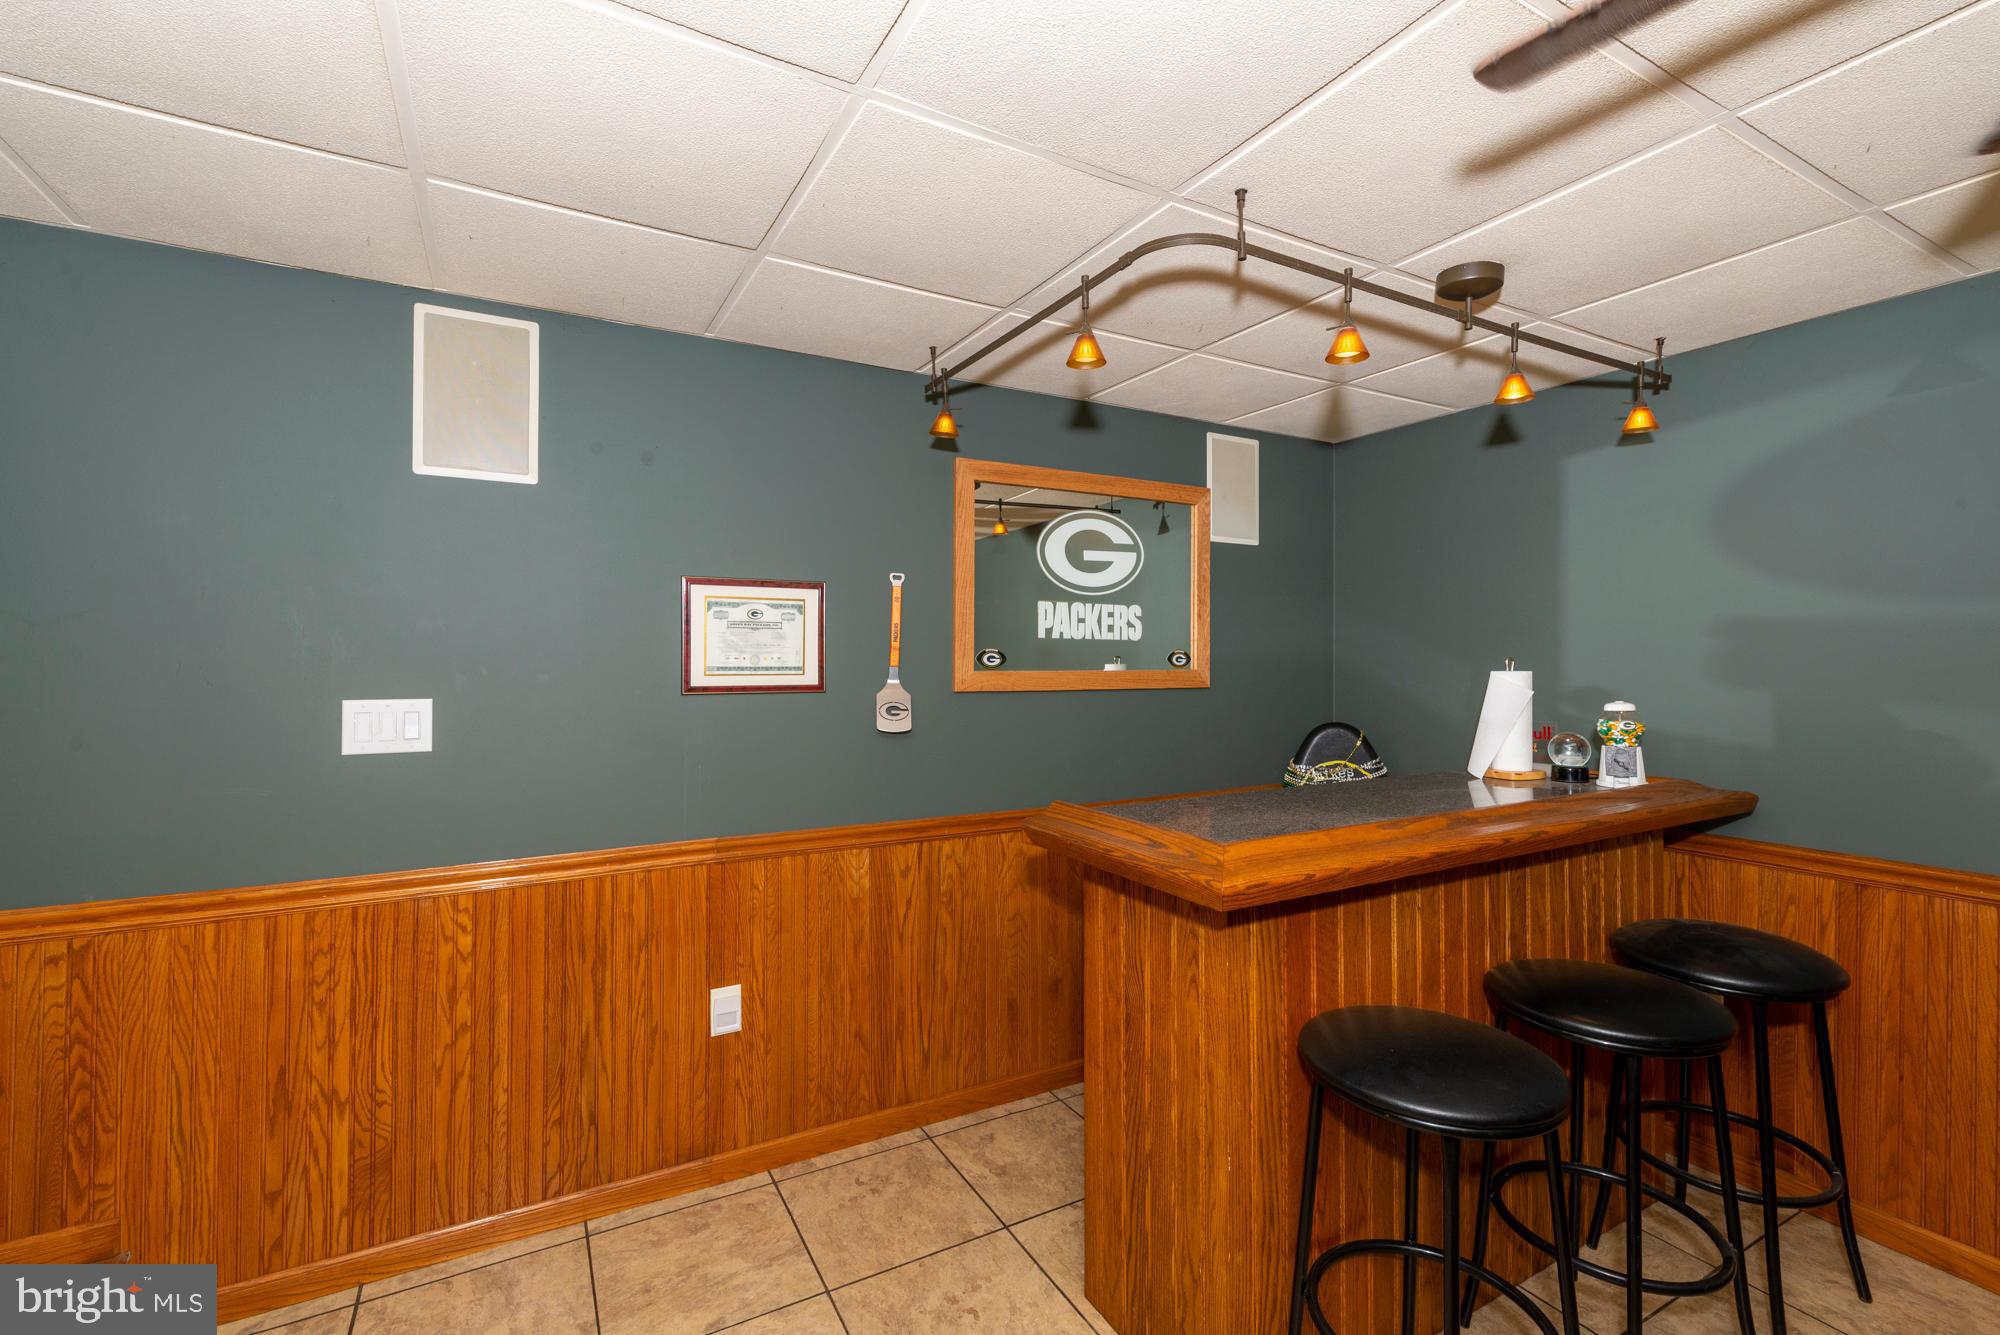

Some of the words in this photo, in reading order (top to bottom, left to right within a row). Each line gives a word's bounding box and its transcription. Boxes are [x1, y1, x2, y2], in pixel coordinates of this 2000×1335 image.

[1043, 517, 1138, 588] G
[1037, 600, 1143, 641] PACKERS
[1532, 725, 1551, 741] ull
